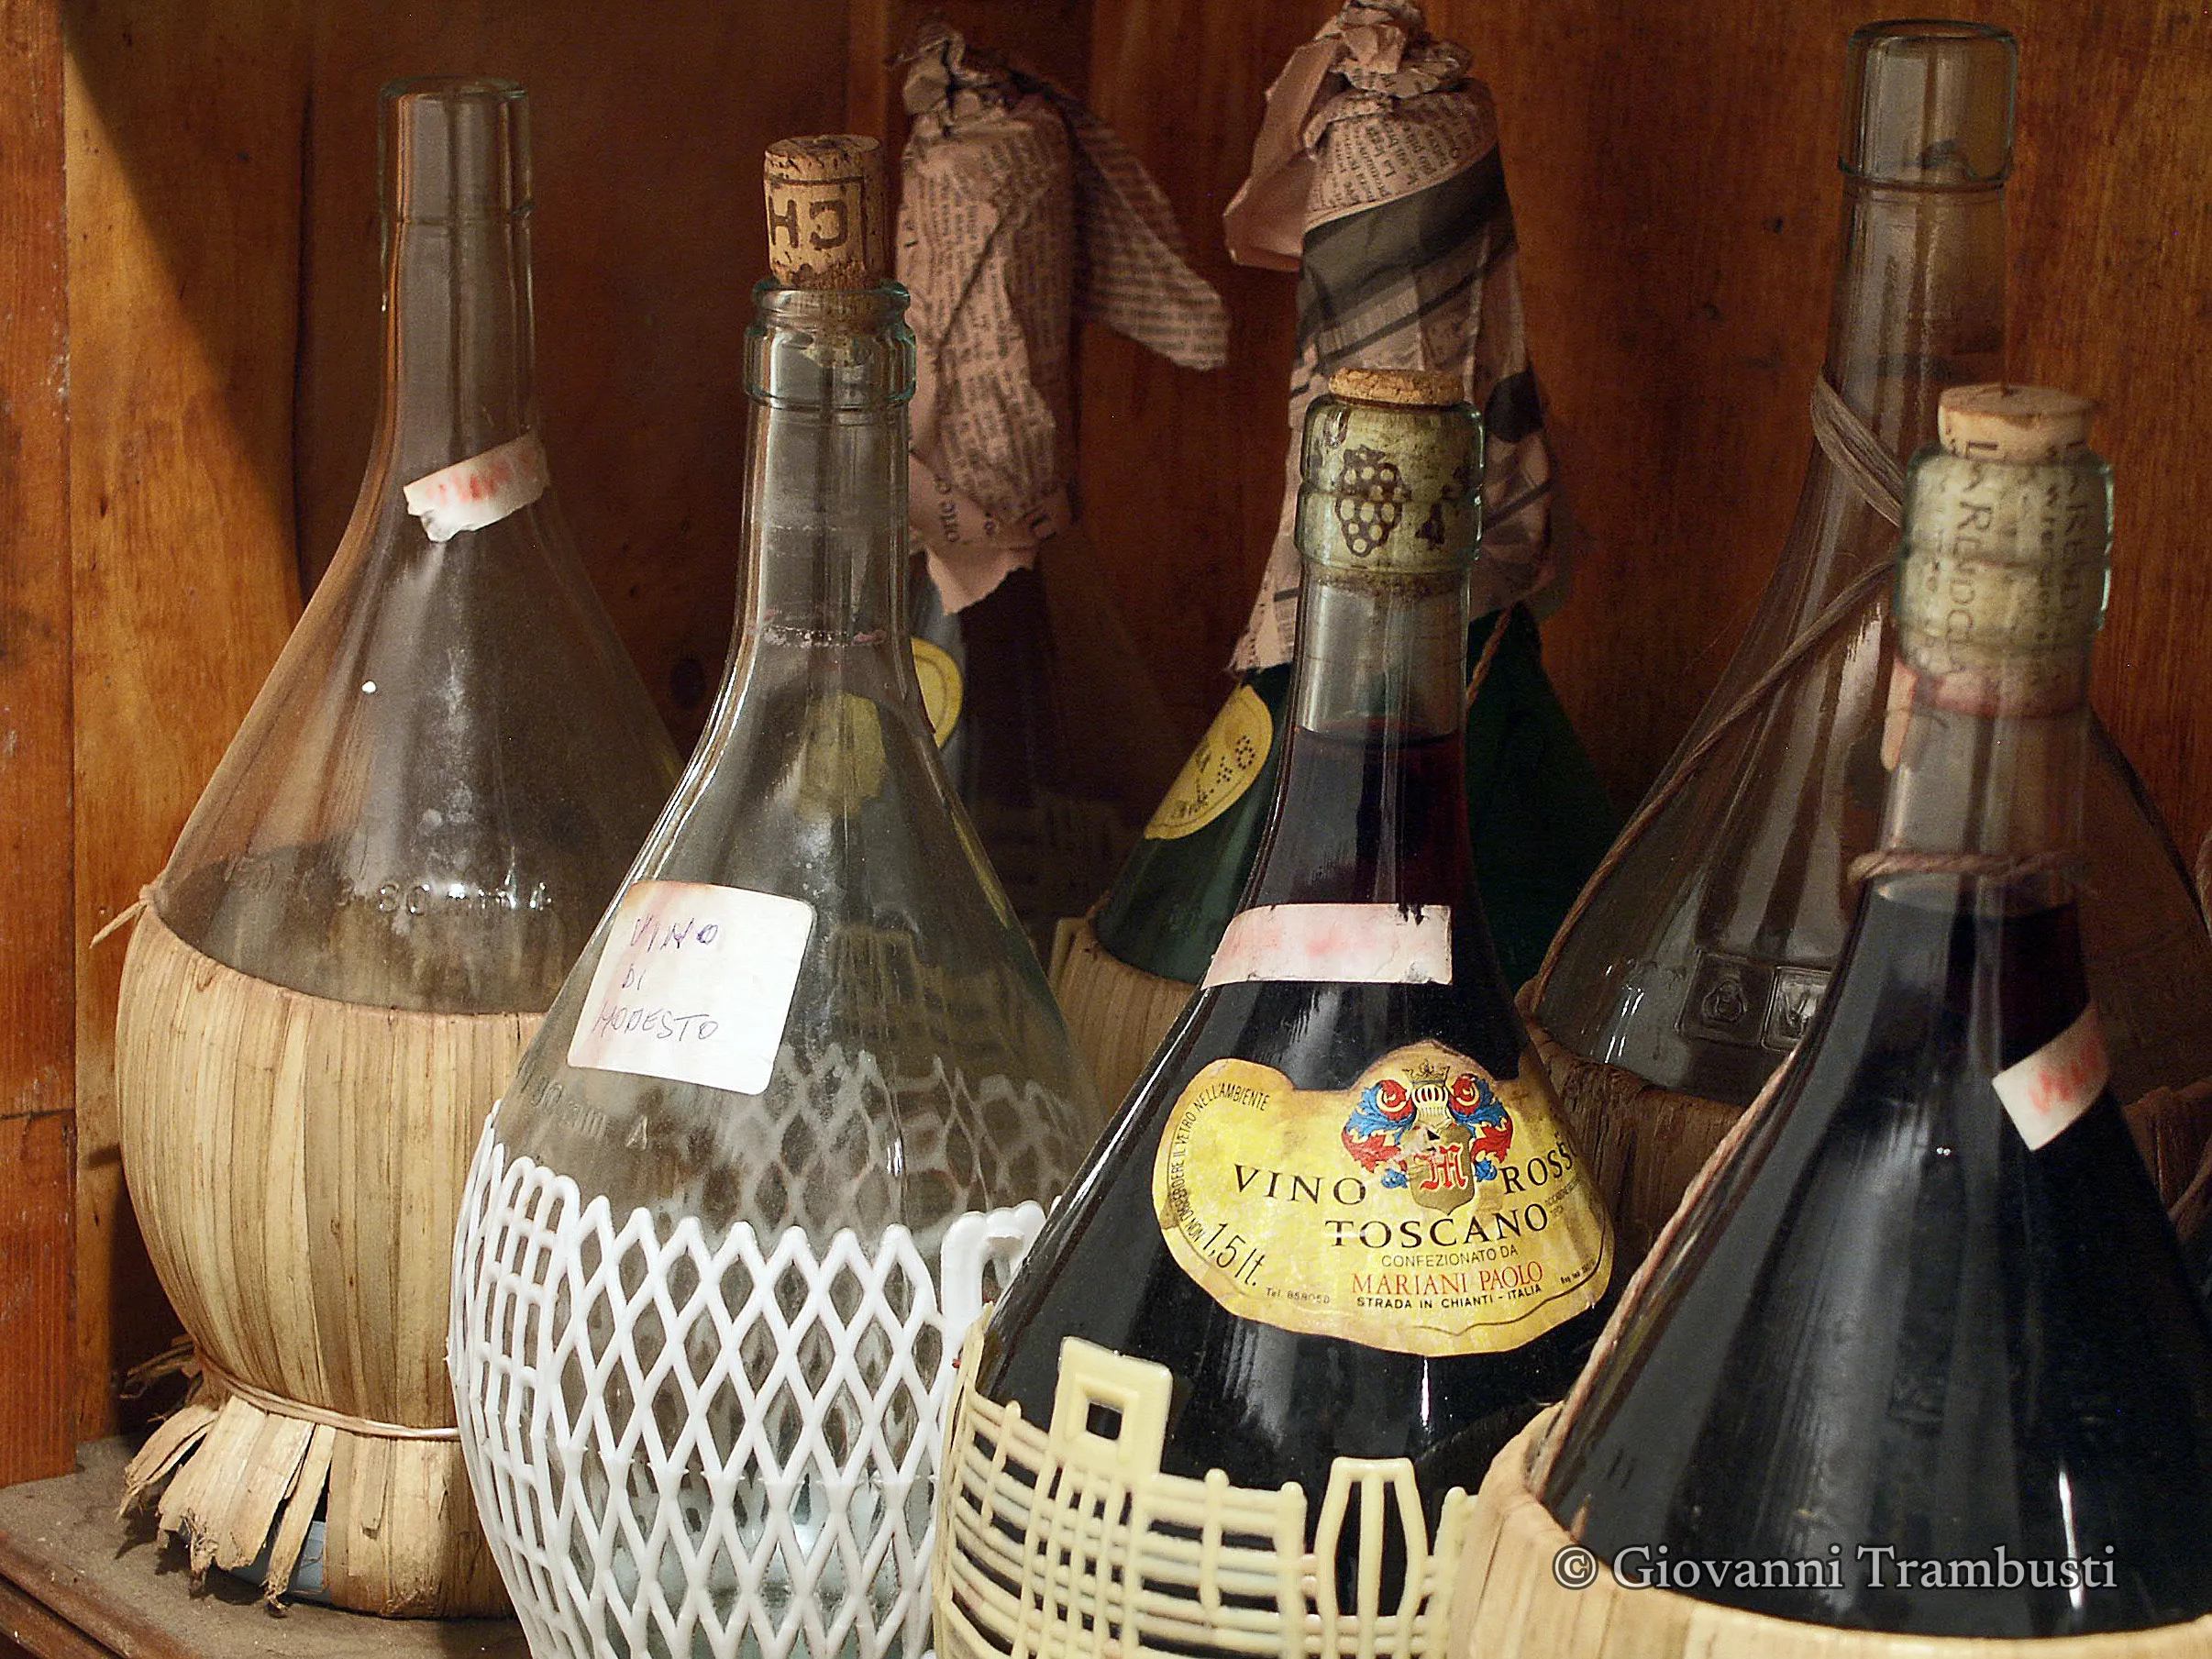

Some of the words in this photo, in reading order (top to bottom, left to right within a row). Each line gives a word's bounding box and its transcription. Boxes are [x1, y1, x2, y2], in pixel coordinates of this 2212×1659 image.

[630, 915, 719, 953] VINO
[1193, 1082, 1270, 1112] NELL'AMBIENTE
[1175, 1111, 1198, 1145] VETRO
[1172, 1147, 1187, 1157] IL
[1233, 1163, 1366, 1206] VINO
[1324, 1203, 1548, 1249] TOSCANO
[1381, 1247, 1497, 1268] CONFEZIONATO
[1500, 1244, 1519, 1259] DA
[1352, 1272, 1468, 1296] MARIANI
[1479, 1260, 1544, 1292] PAOLO
[1356, 1296, 1411, 1310] STRADA
[1420, 1300, 1432, 1310] IN
[1441, 1294, 1493, 1309] CHIANTI
[1507, 1283, 1543, 1301] ITALIA
